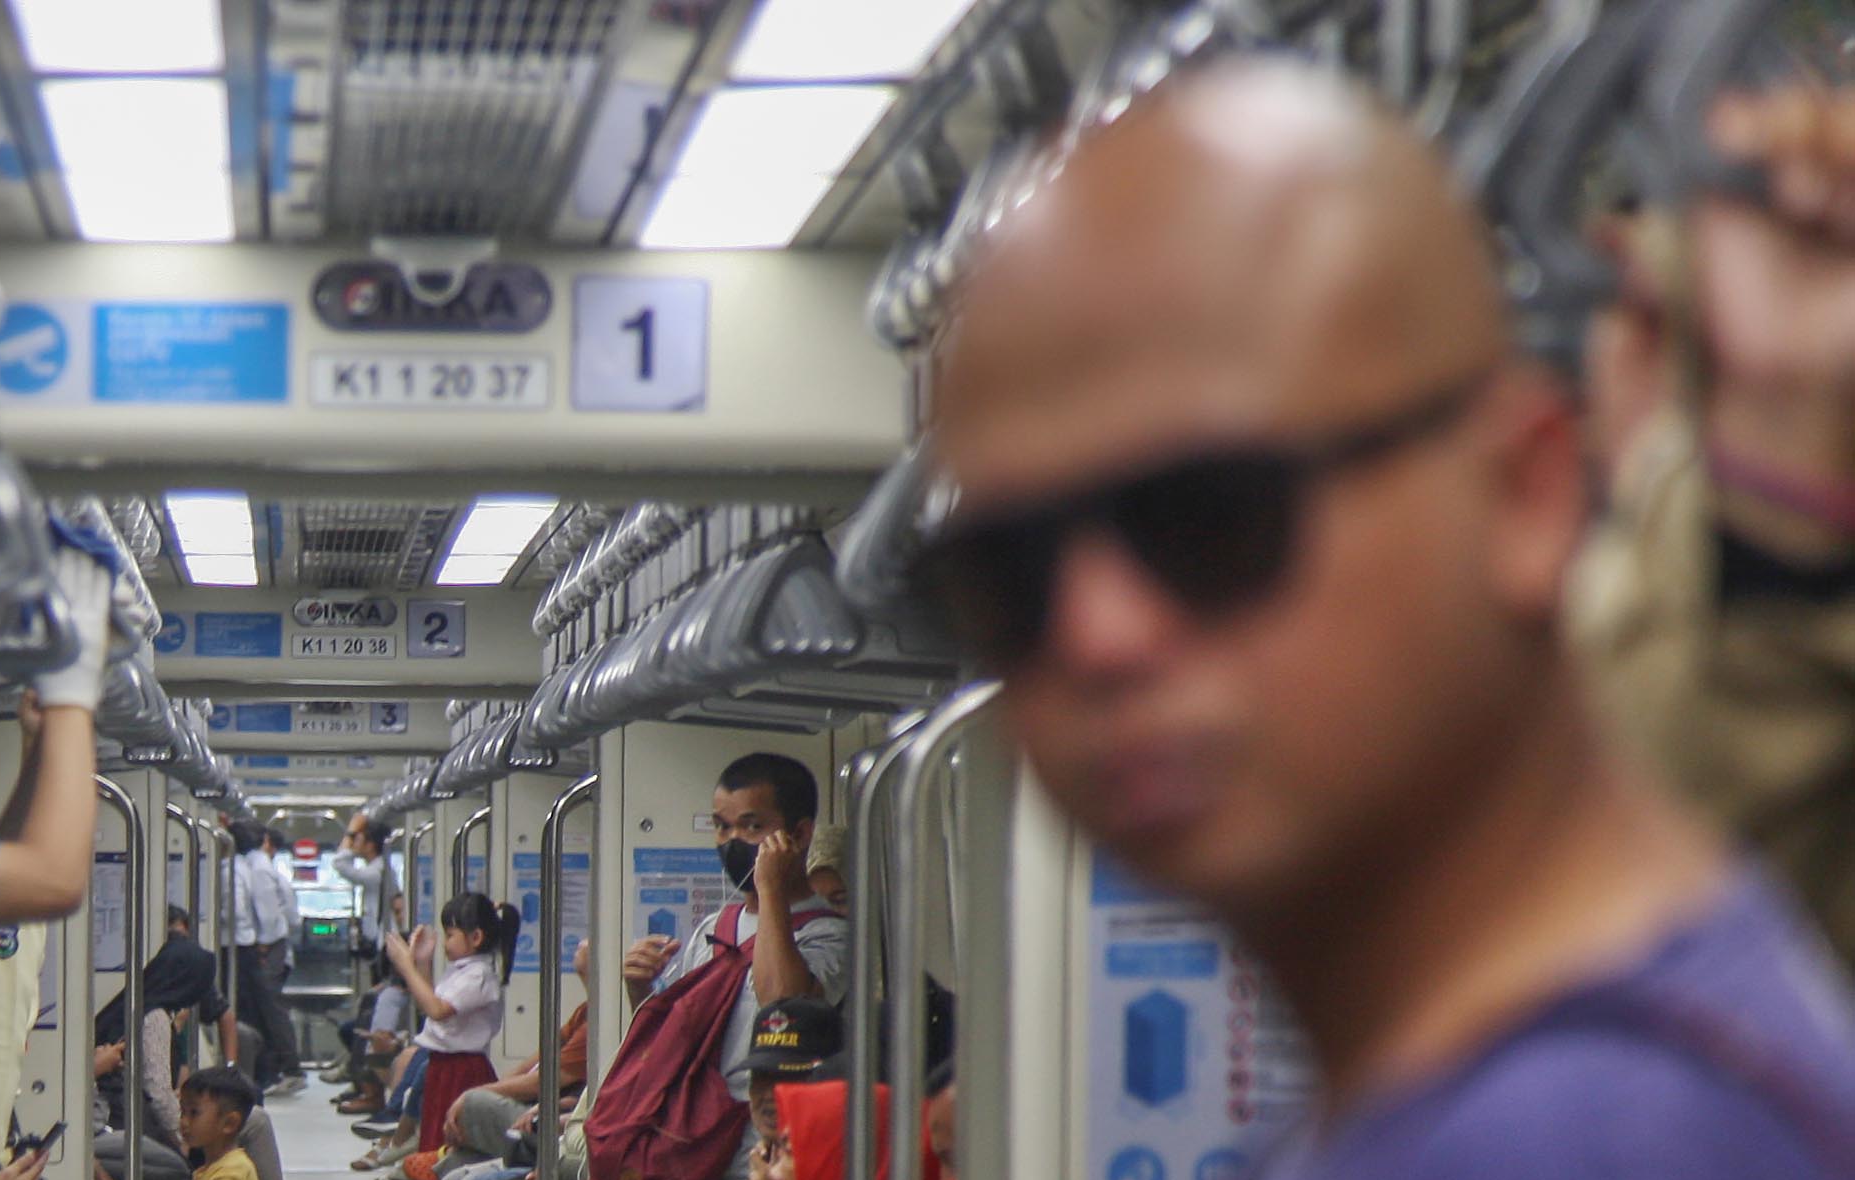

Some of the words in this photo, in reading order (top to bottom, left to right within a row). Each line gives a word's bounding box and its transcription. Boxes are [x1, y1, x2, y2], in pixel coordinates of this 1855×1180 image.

[621, 306, 656, 381] 1
[333, 365, 380, 397] K1
[398, 365, 415, 397] 1
[431, 365, 474, 397] 20
[488, 365, 531, 397] 37
[423, 611, 450, 644] 2
[302, 638, 322, 653] K1
[330, 638, 337, 653] 1
[344, 638, 363, 653] 20
[369, 638, 387, 653] 38
[381, 704, 397, 726] 3
